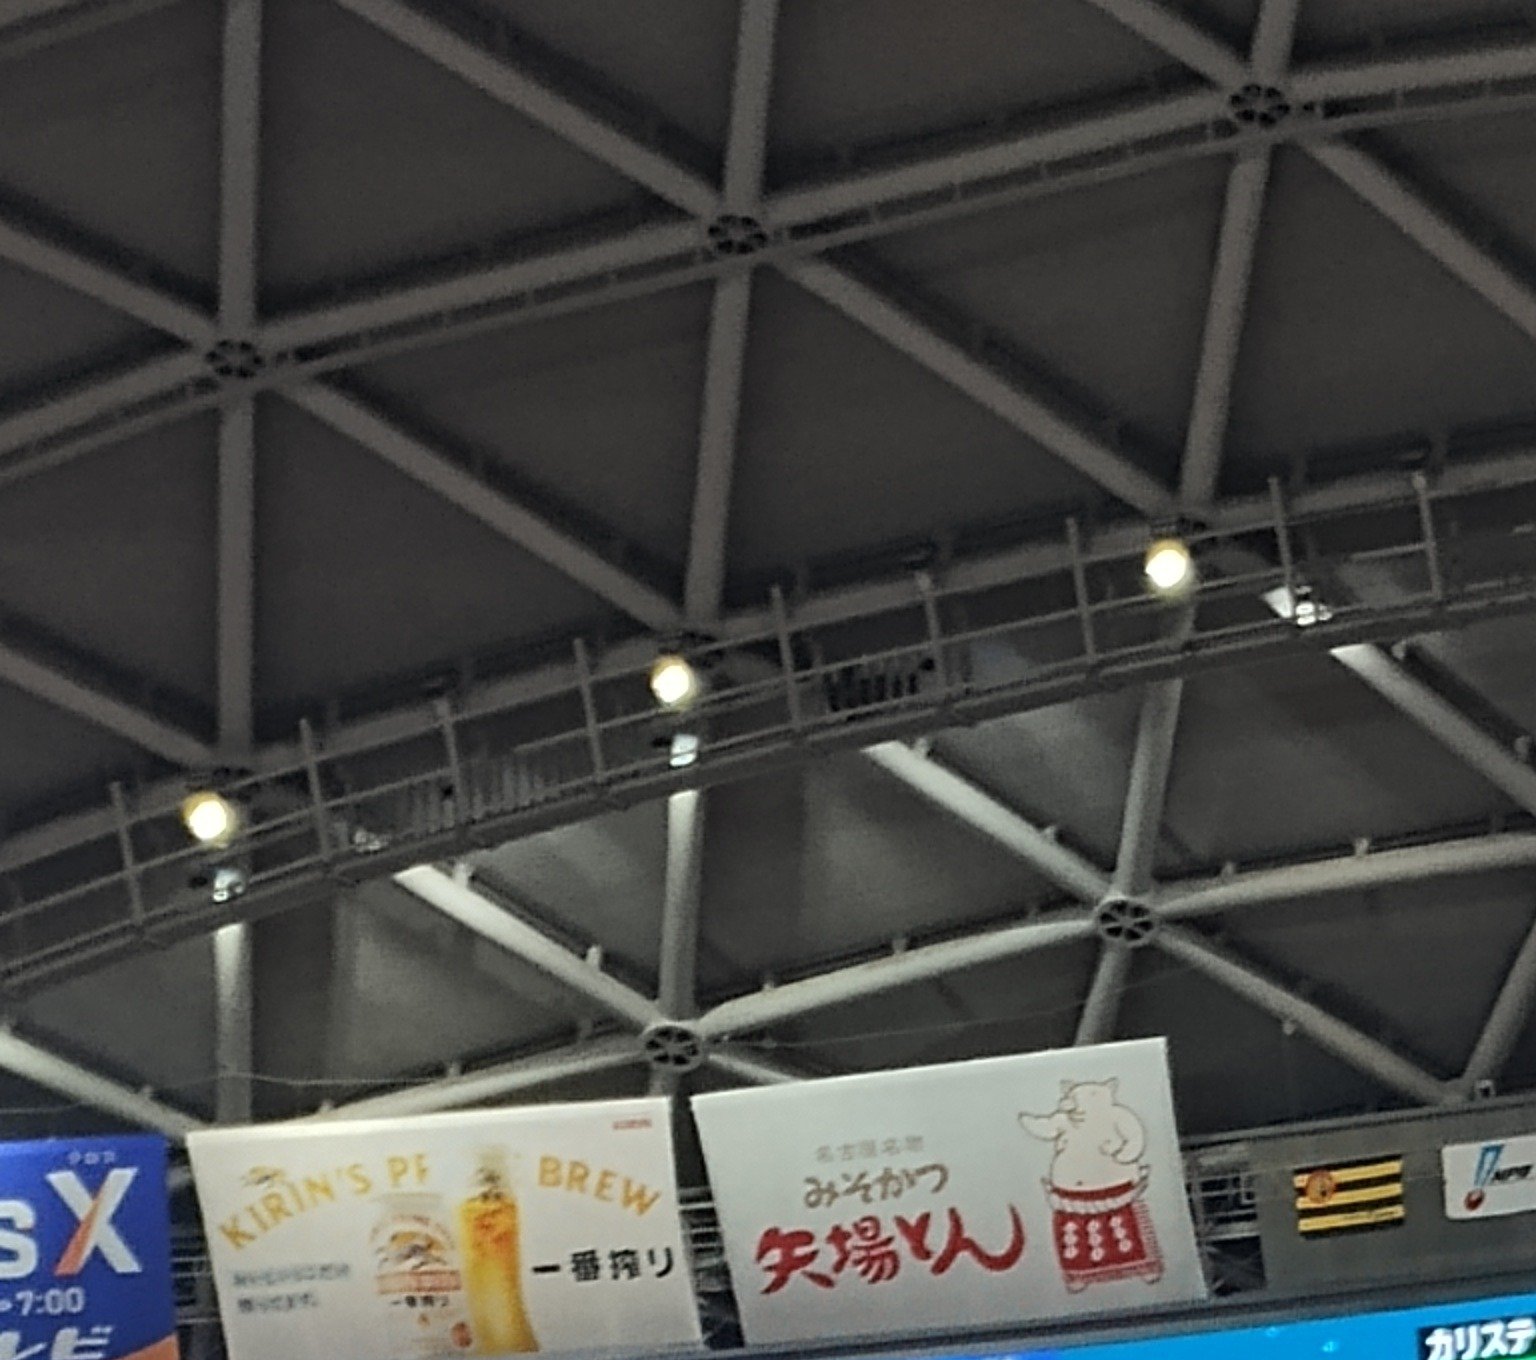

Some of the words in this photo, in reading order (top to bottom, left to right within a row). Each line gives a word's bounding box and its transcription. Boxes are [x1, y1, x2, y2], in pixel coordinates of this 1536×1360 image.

[537, 1155, 662, 1217] BREW
[803, 1163, 949, 1209] みそかつ
[531, 1247, 674, 1283] 一番搾り
[755, 1202, 1026, 1295] 矢場とん
